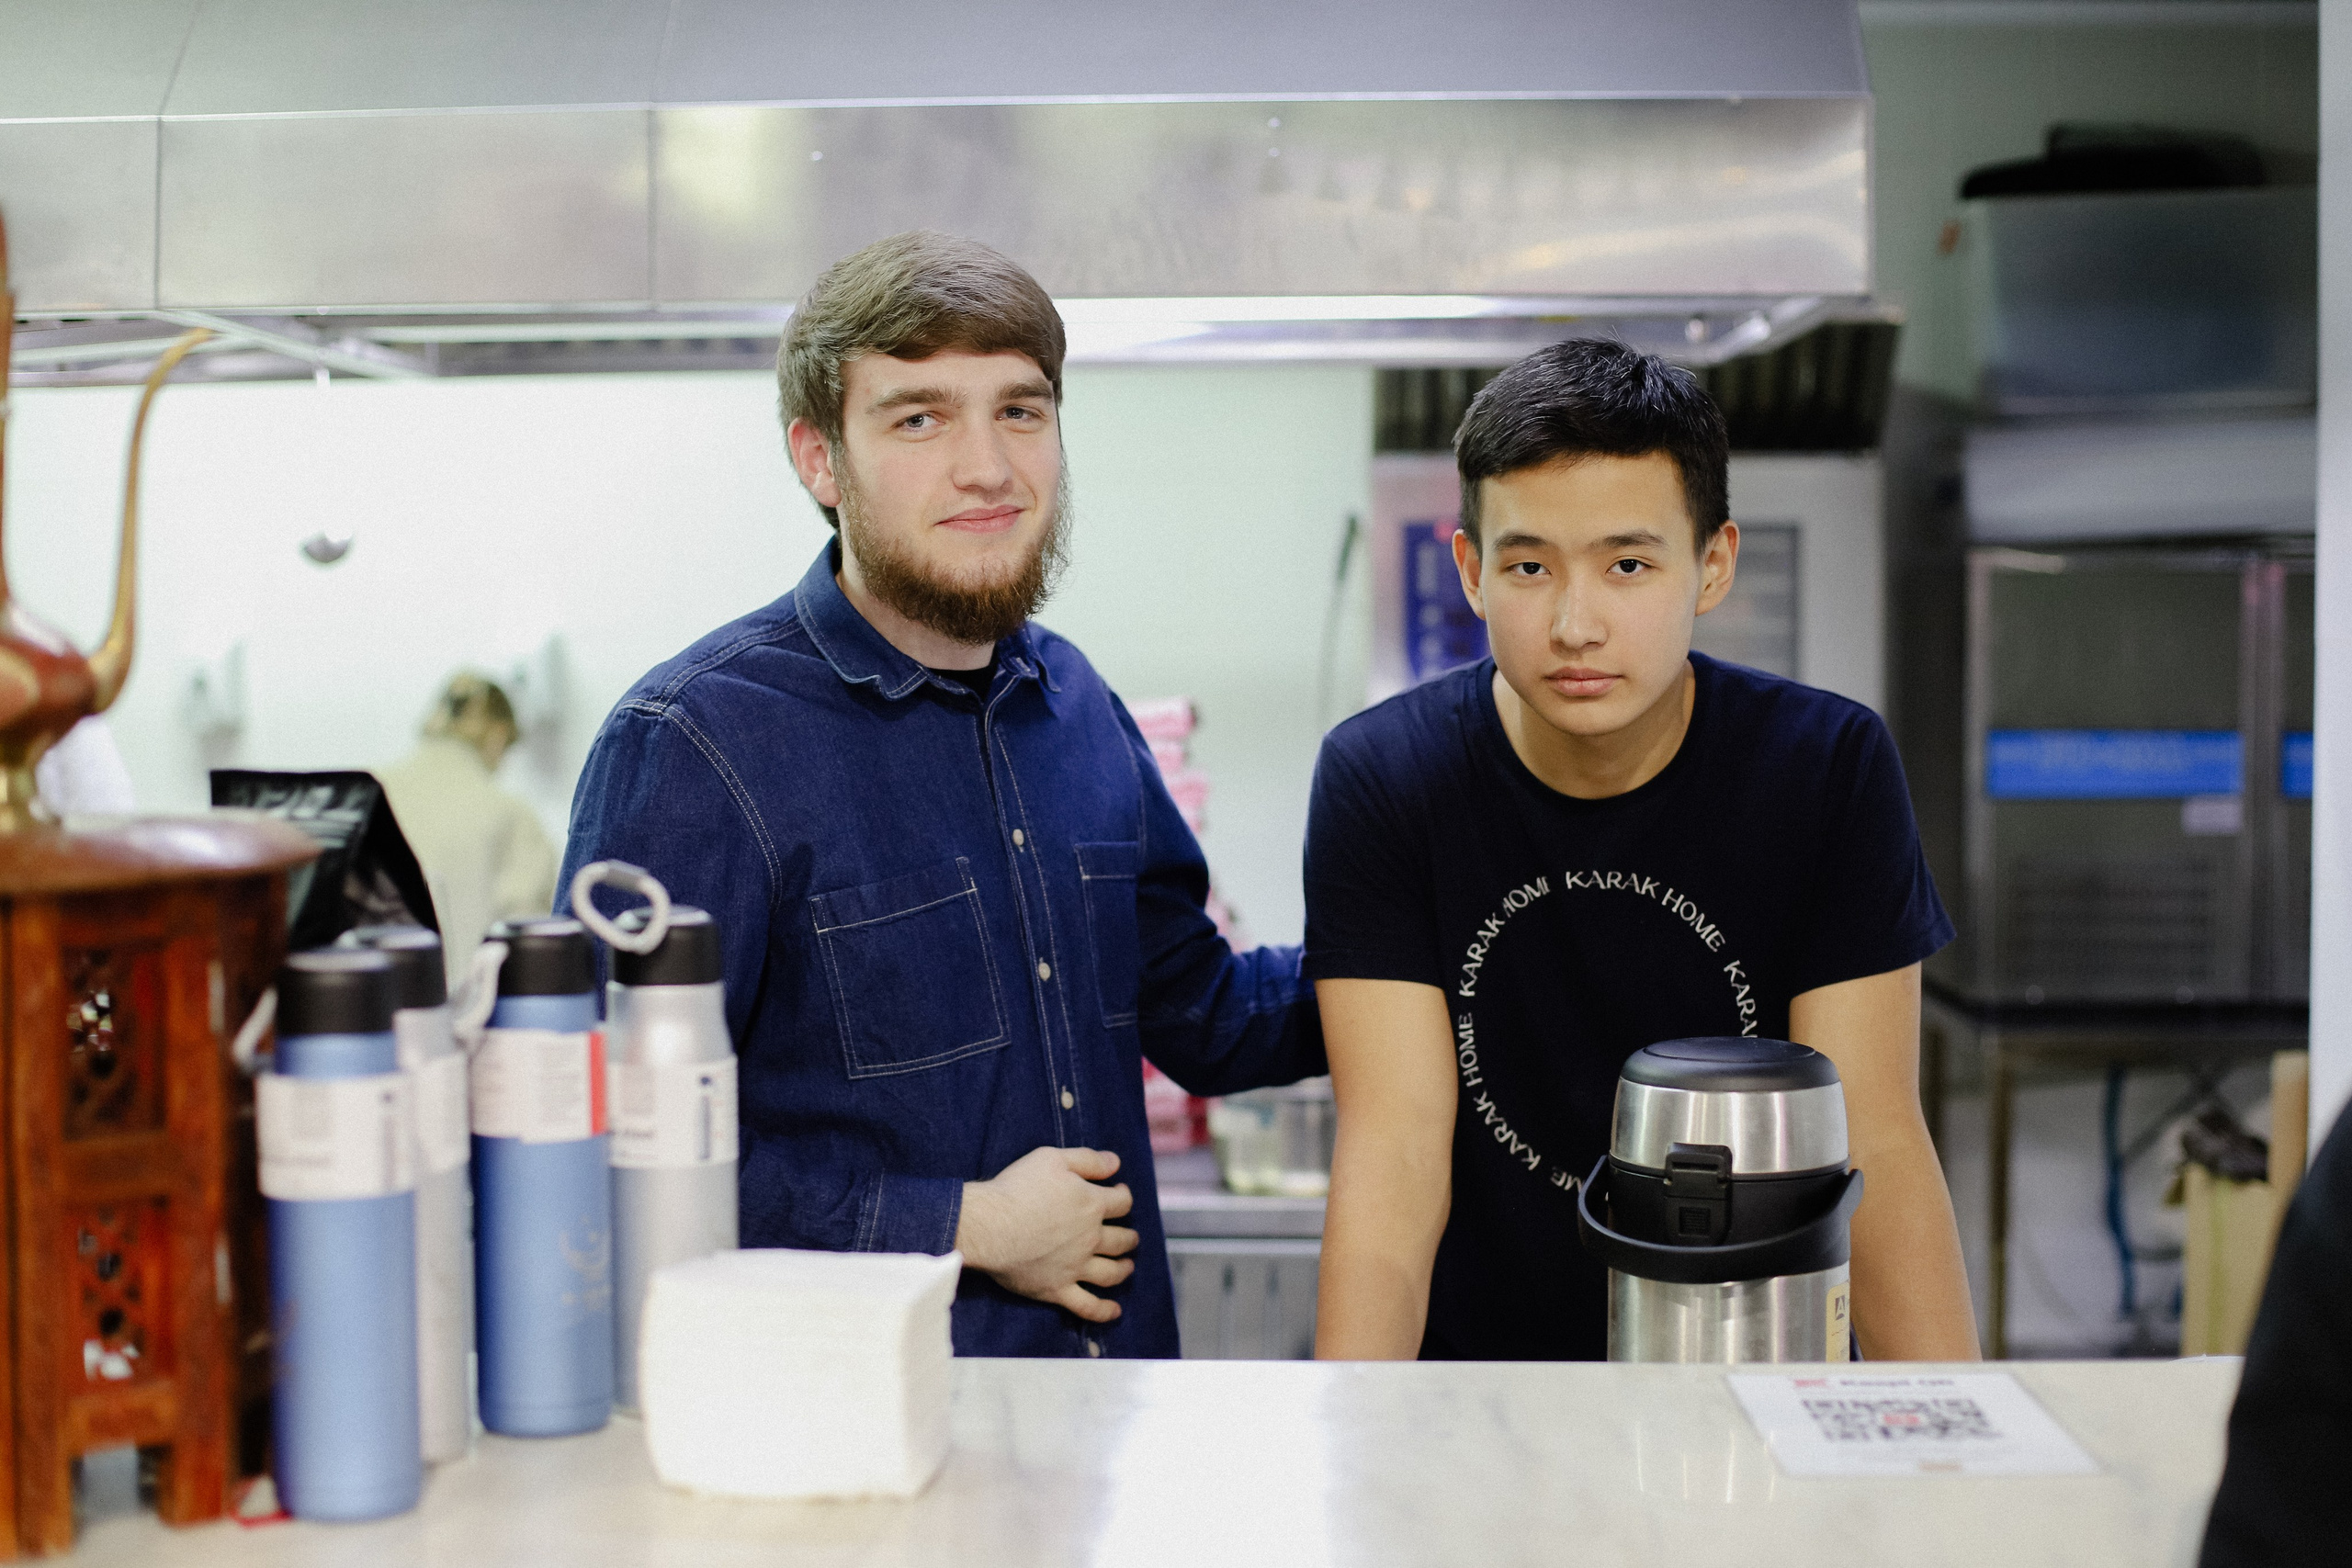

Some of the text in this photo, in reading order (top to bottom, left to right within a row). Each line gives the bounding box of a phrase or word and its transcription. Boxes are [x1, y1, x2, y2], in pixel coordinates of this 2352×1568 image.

[1565, 870, 1660, 899] KARAK
[1661, 887, 1726, 953] HOME
[1458, 912, 1505, 998] KARAK
[1723, 960, 1758, 1037] KARA
[1458, 1012, 1483, 1088] HOME
[1473, 1090, 1542, 1171] KARAK
